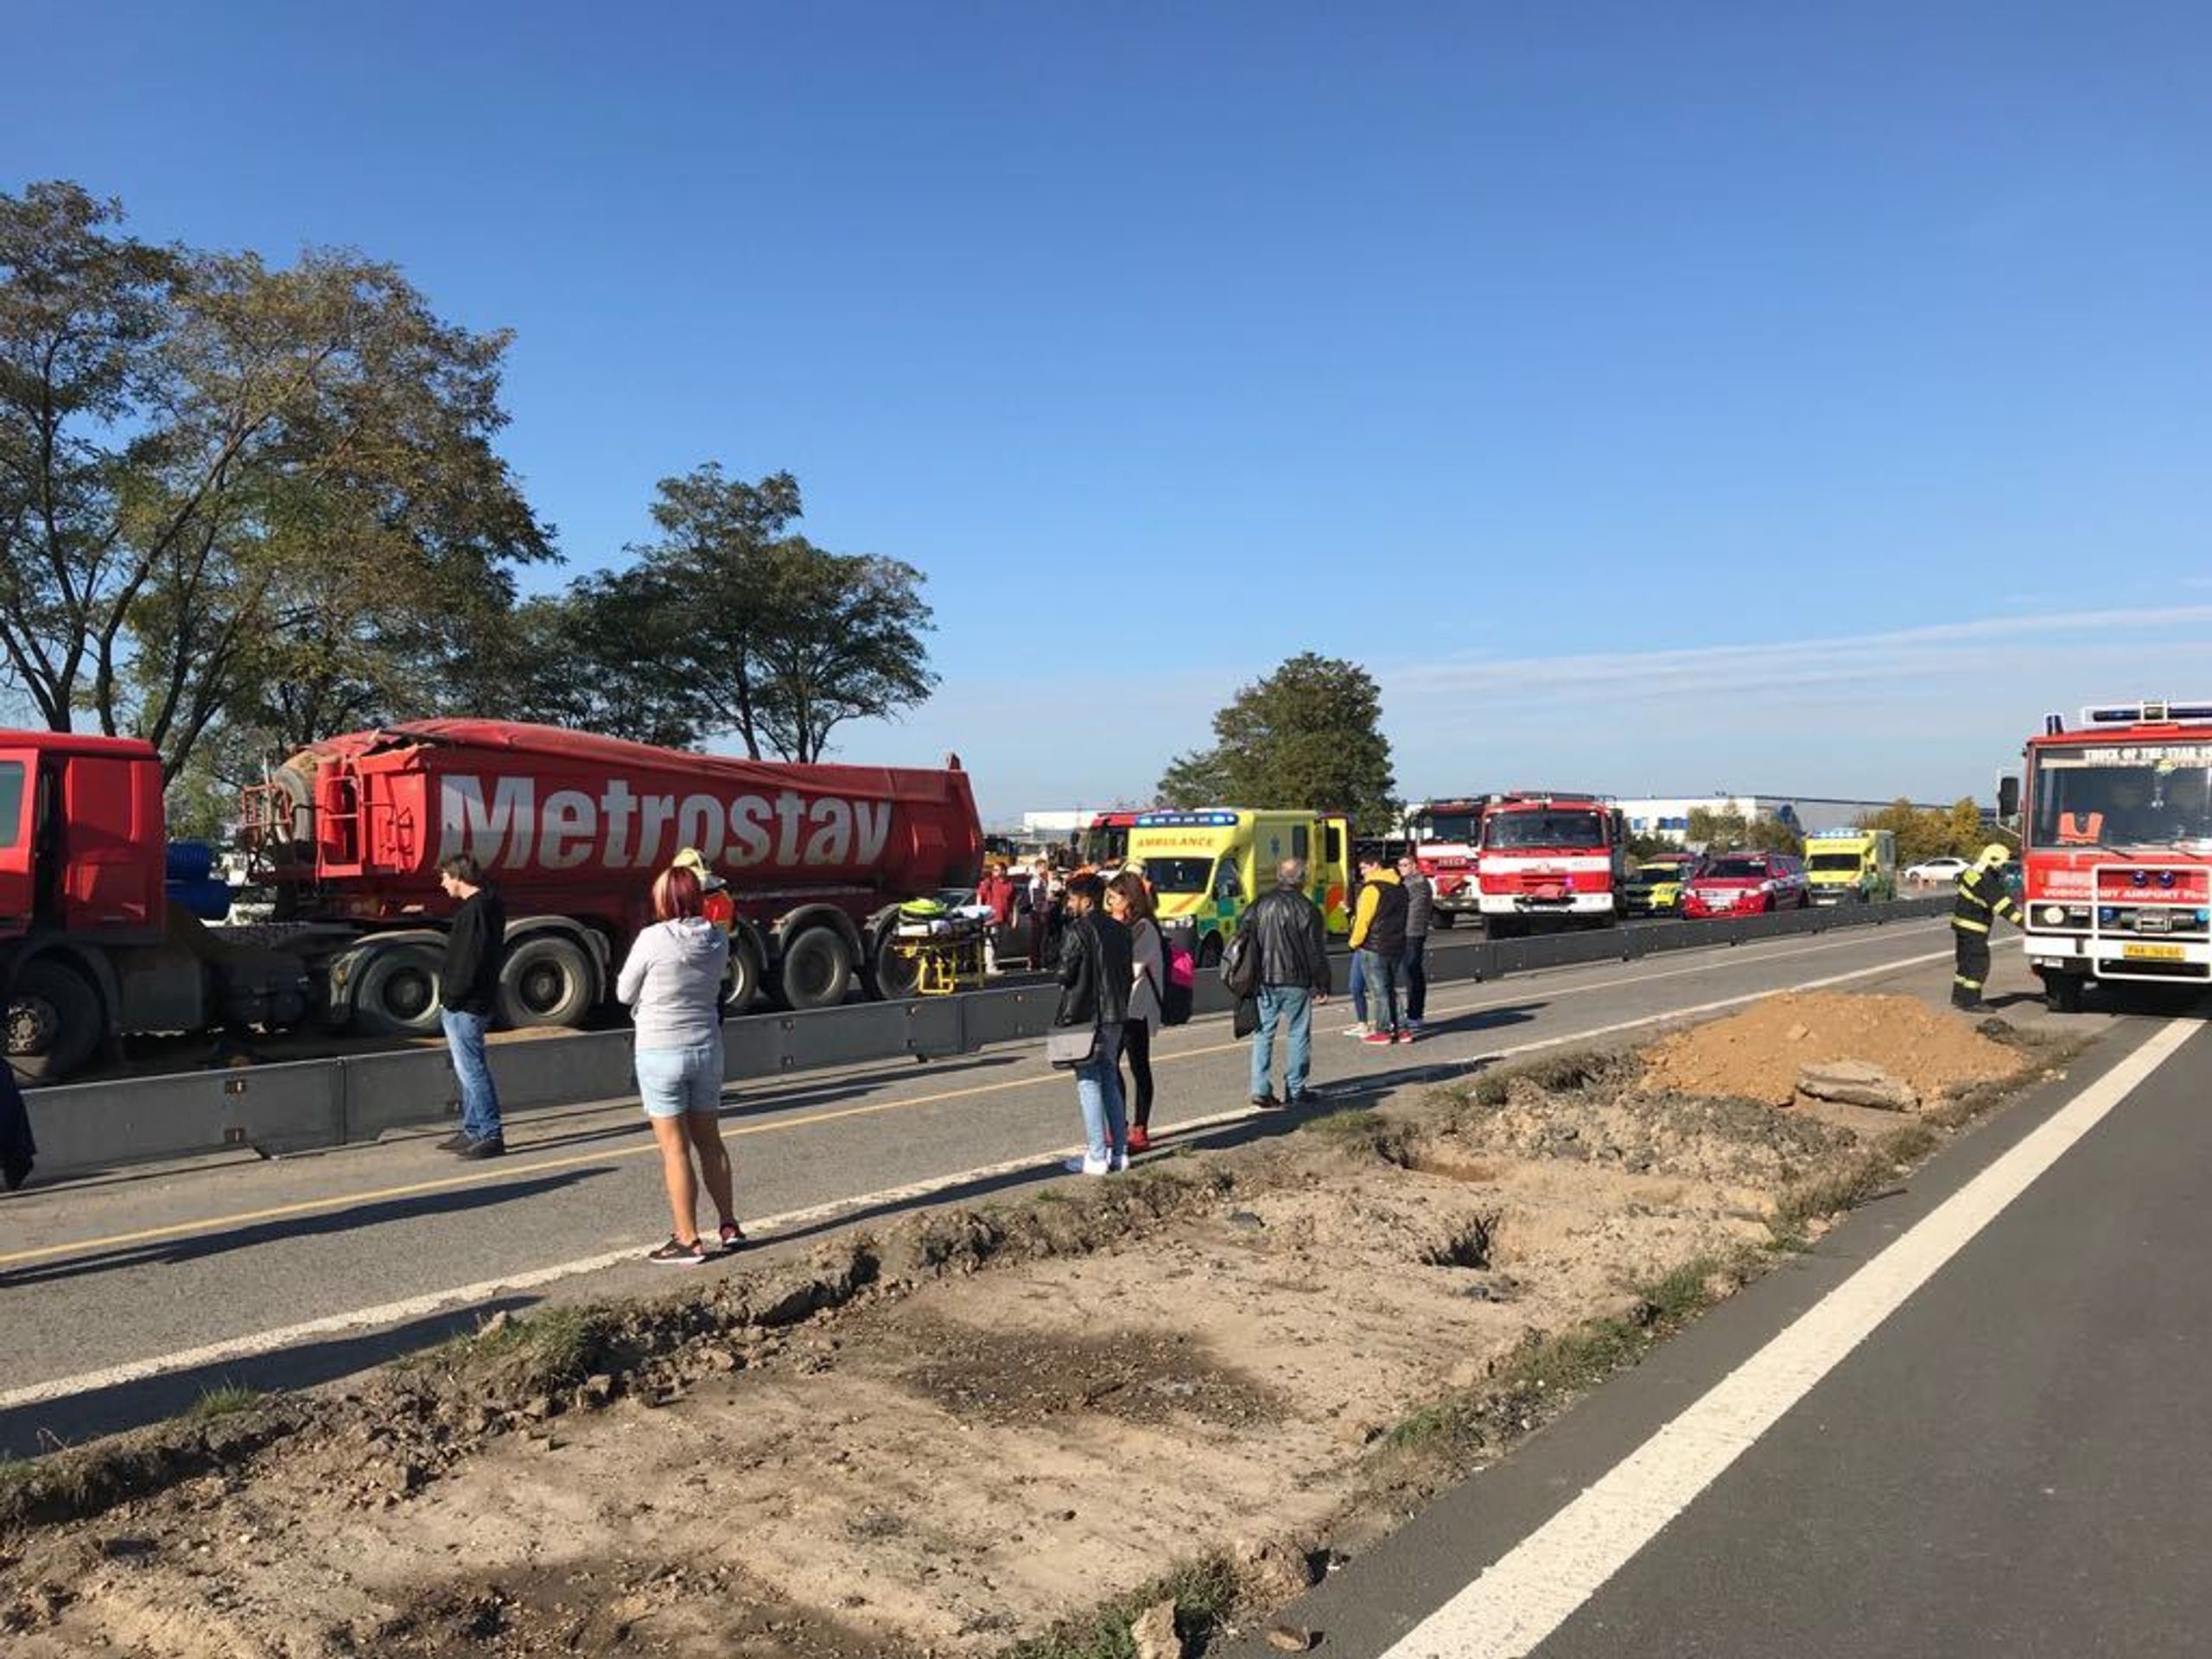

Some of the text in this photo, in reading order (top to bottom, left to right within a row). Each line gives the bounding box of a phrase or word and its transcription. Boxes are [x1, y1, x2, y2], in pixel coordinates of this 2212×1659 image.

[2121, 748, 2139, 760] OF
[439, 773, 892, 870] Metrostav
[1136, 836, 1215, 848] AMBULANCE
[2123, 890, 2179, 899] AIRPORT
